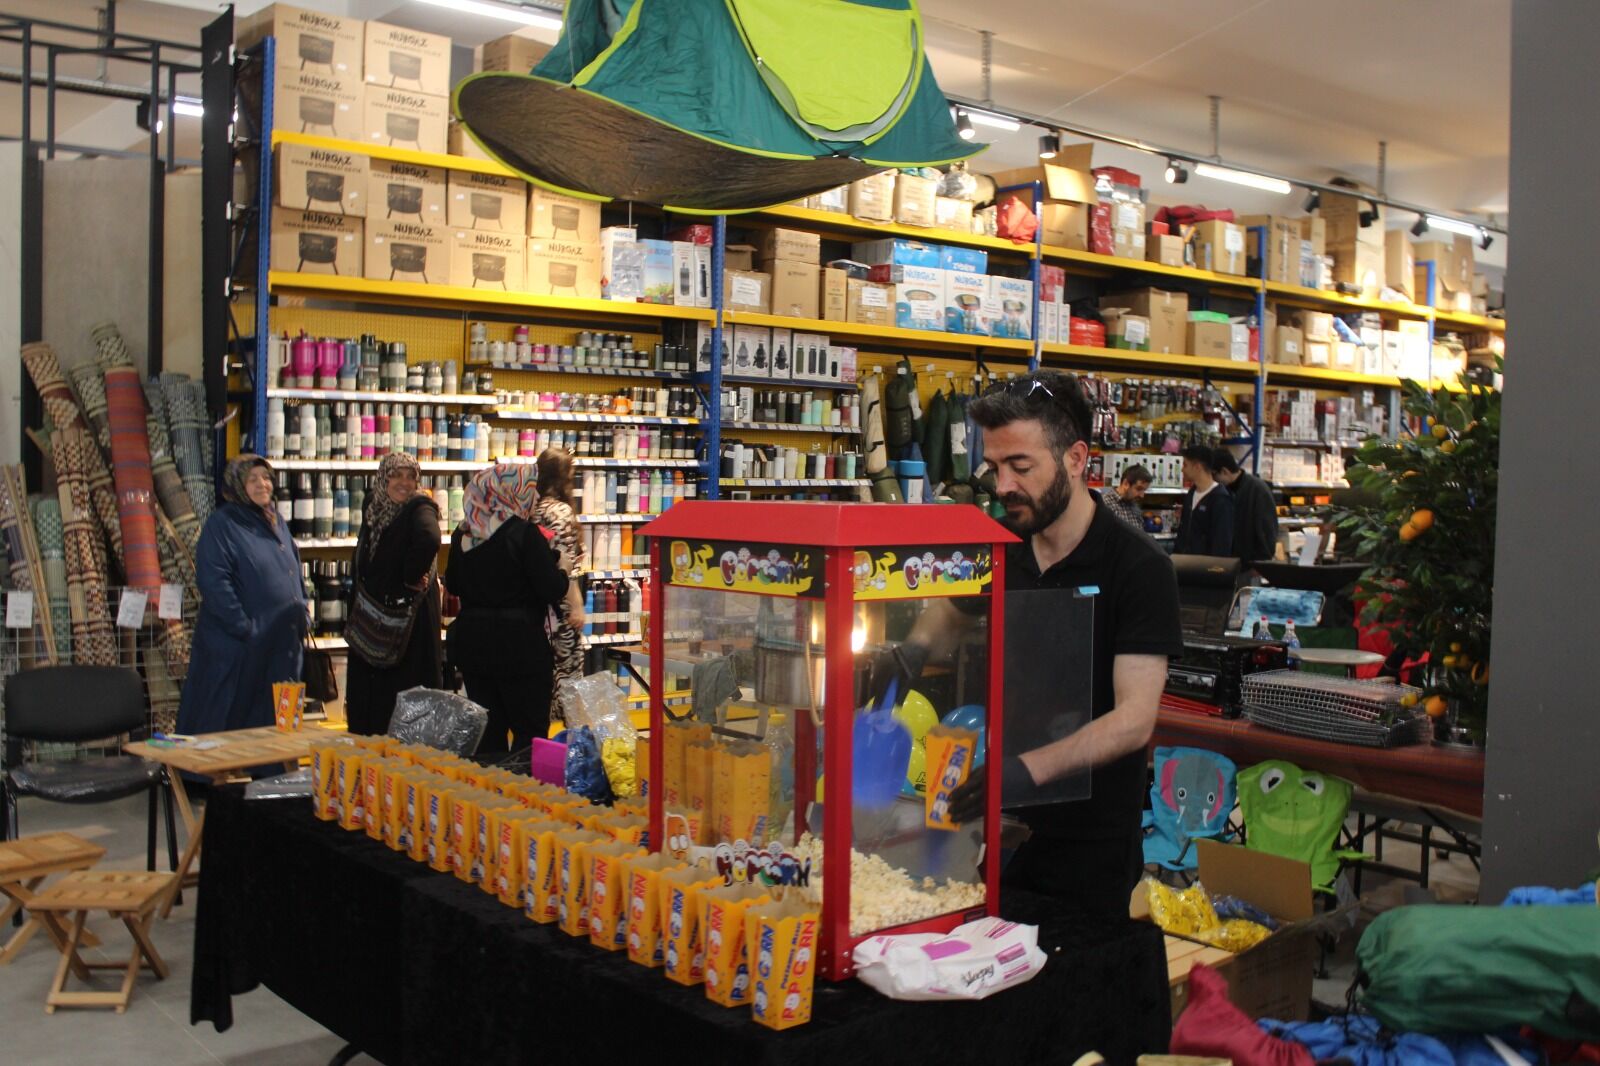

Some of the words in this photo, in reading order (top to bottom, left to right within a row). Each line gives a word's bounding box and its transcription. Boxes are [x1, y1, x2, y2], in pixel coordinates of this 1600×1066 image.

[942, 744, 969, 790] CORN
[782, 981, 801, 1020] POP
[792, 920, 817, 978] CORN
